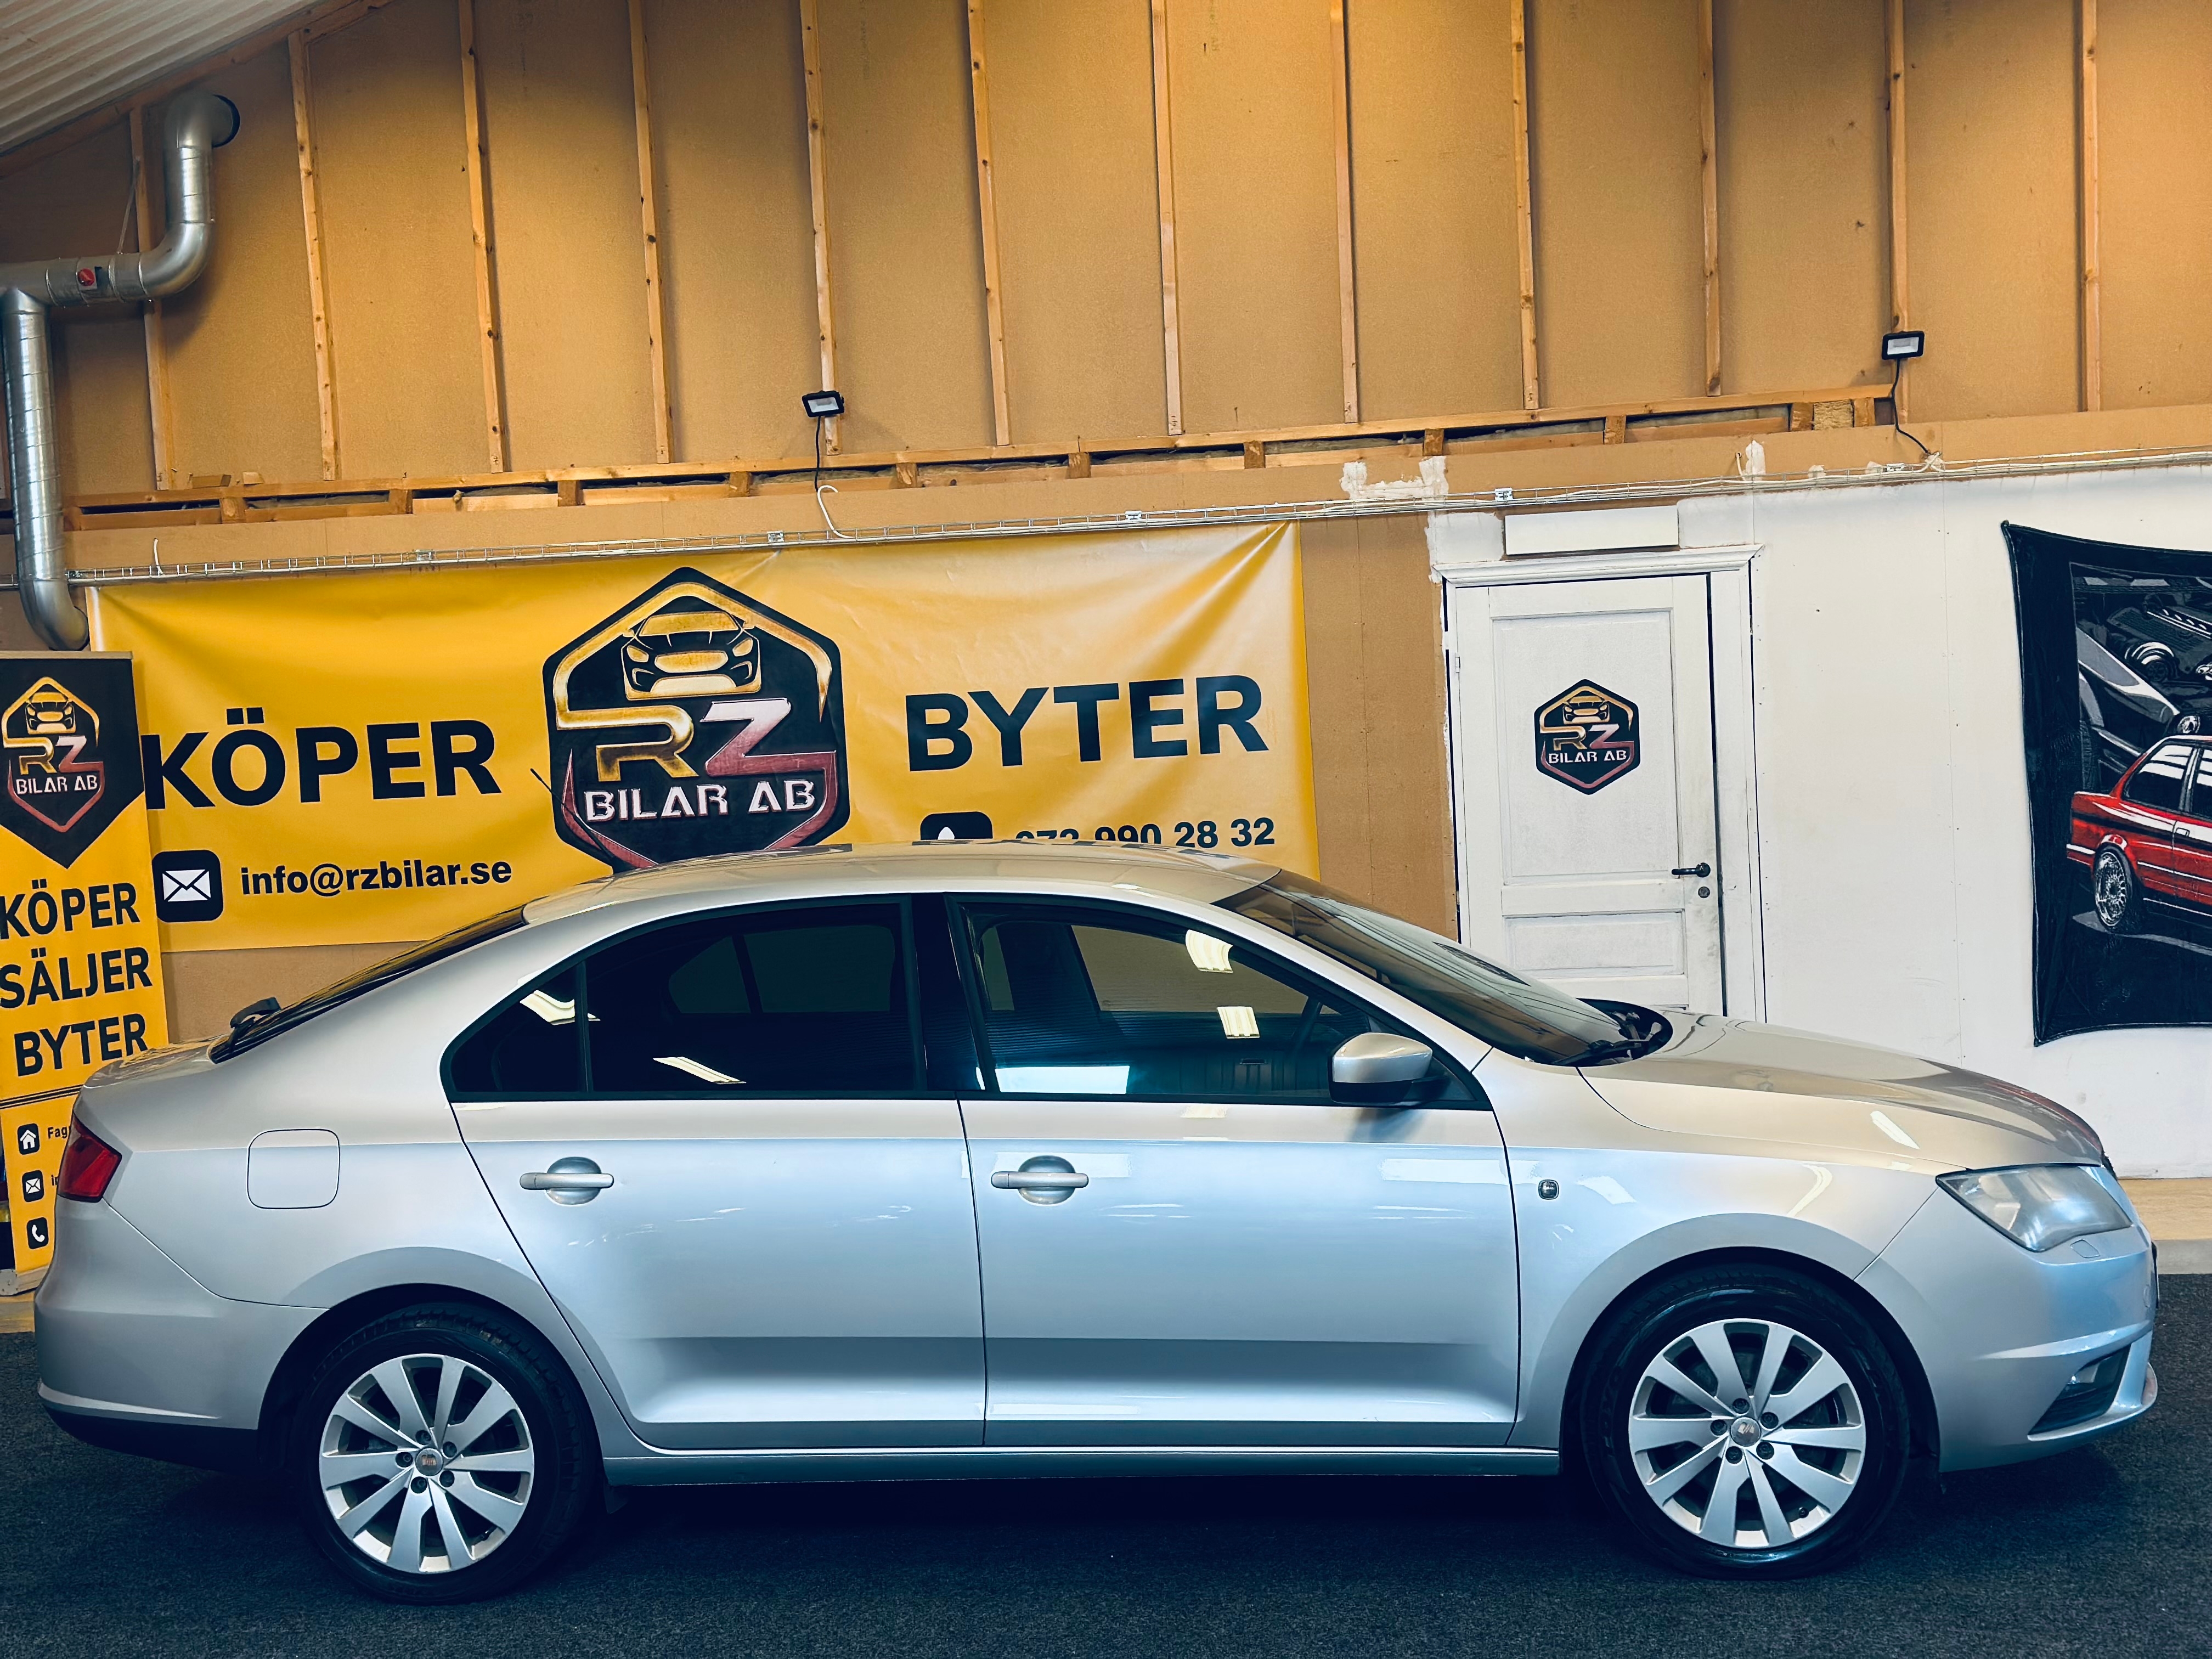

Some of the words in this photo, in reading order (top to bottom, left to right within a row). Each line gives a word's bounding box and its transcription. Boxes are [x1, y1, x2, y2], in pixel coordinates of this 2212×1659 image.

[556, 697, 837, 782] RZ
[906, 675, 1269, 772] BYTER
[1539, 723, 1634, 751] RZ
[3, 735, 104, 775] RZ
[141, 707, 502, 810] KÖPER
[1548, 751, 1598, 764] BILAR
[1604, 749, 1627, 761] AB
[15, 776, 68, 795] BILAR
[74, 775, 98, 791] AB
[583, 783, 729, 822] BILAR
[747, 779, 815, 814] AB
[1174, 820, 1219, 849] 28
[1231, 817, 1276, 847] 32
[240, 859, 512, 897] info@rzbilar.se
[0, 878, 140, 940] KÖPER
[0, 947, 153, 1009] SÄLJER
[14, 1013, 149, 1077] BYTER
[48, 1126, 71, 1139] Fag
